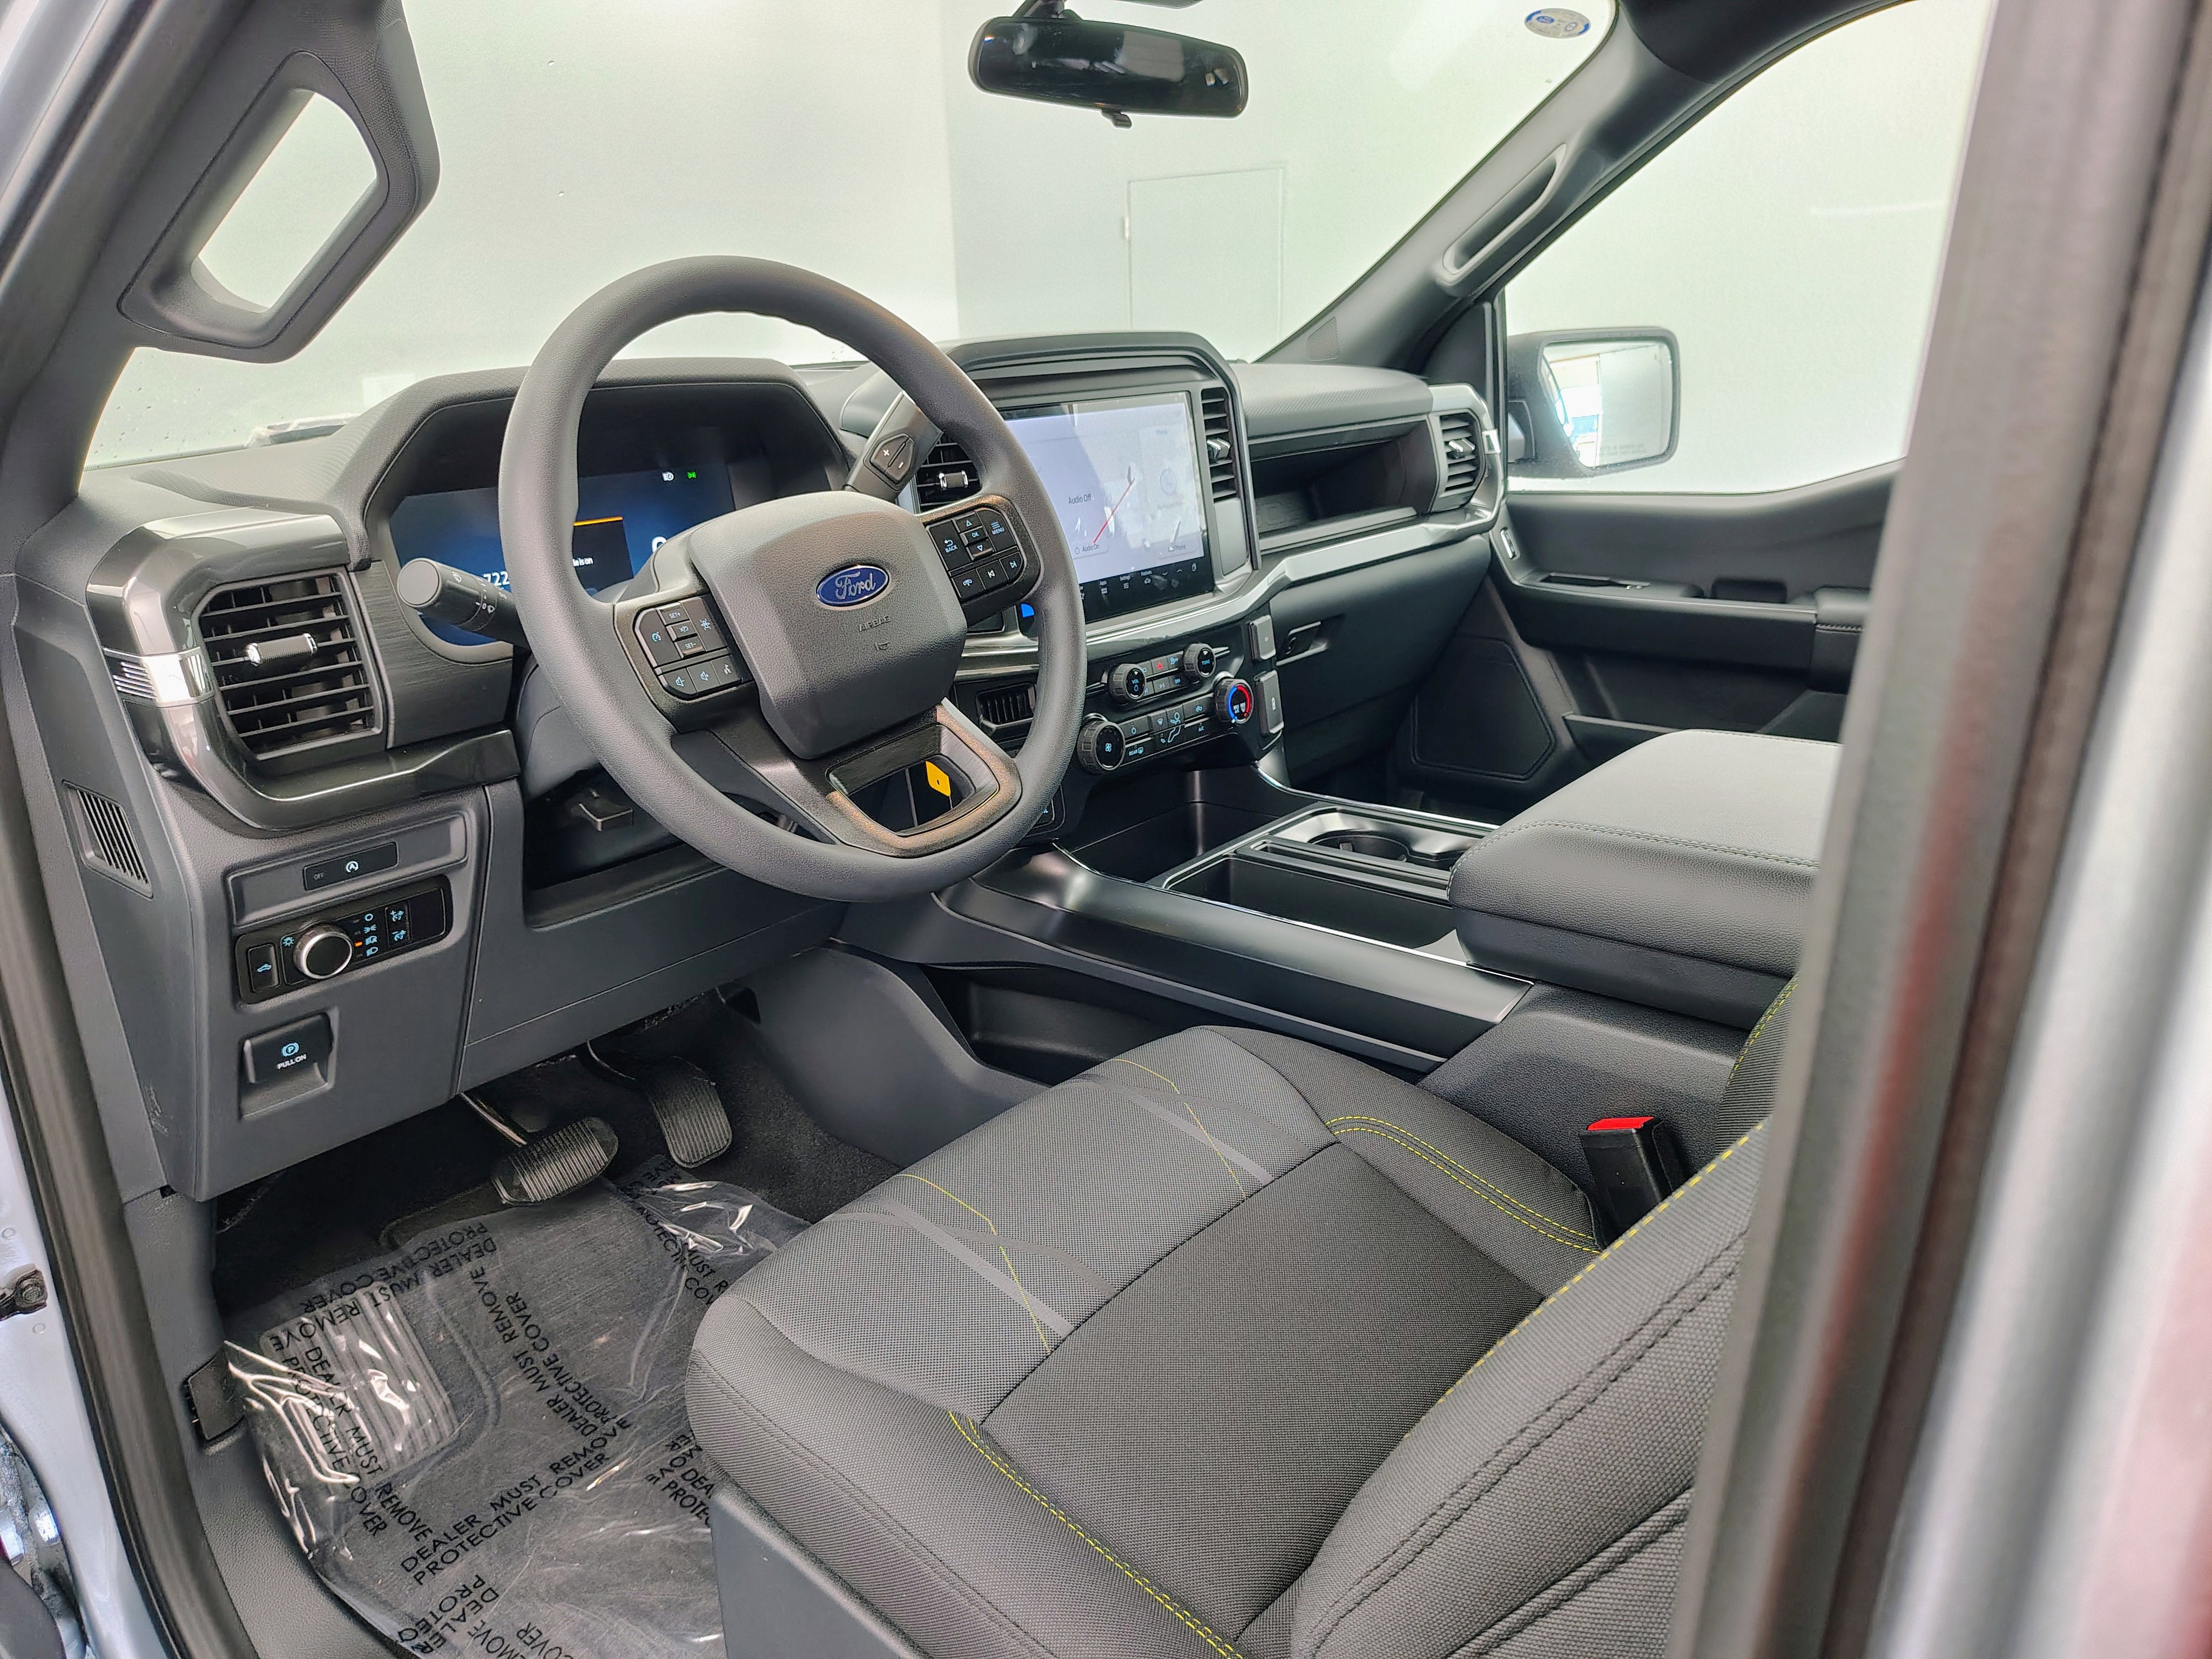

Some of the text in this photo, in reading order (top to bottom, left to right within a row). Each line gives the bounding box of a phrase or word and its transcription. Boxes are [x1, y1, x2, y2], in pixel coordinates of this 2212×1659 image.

[1068, 494, 1091, 505] Audio Off
[945, 545, 958, 553] BACK
[992, 527, 1005, 535] MENU
[835, 571, 876, 599] Ford
[278, 1054, 307, 1069] PULL ON
[270, 1298, 360, 1351] REMOVE
[470, 1266, 598, 1437] DEALER MUST REMOVE
[506, 1292, 617, 1424] PROTECTIVE COVER
[346, 1426, 383, 1475] MUST
[376, 1482, 433, 1542] REMOVE
[401, 1420, 631, 1572] DEALER MUST REMOVE
[681, 1469, 715, 1499] DEA
[414, 1453, 610, 1586] PROTECTIVE COVER
[516, 1622, 574, 1659] OVER
